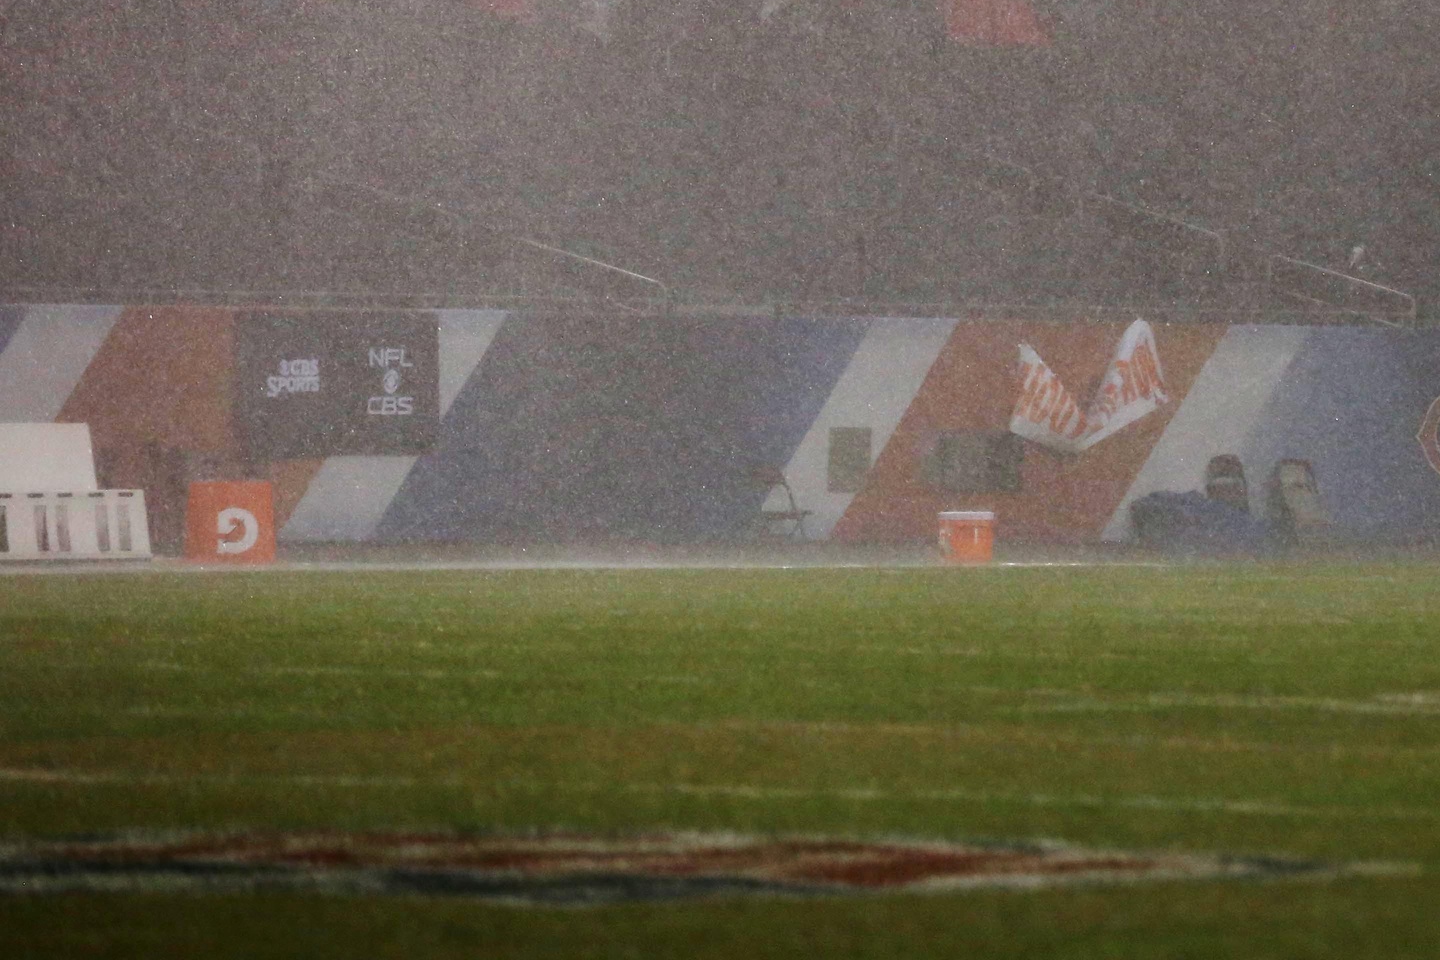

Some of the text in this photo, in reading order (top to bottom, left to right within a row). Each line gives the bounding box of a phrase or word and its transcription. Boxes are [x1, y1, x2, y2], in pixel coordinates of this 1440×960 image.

[368, 347, 413, 367] NFL
[267, 375, 319, 397] SPORTS
[367, 397, 413, 415] CBS
